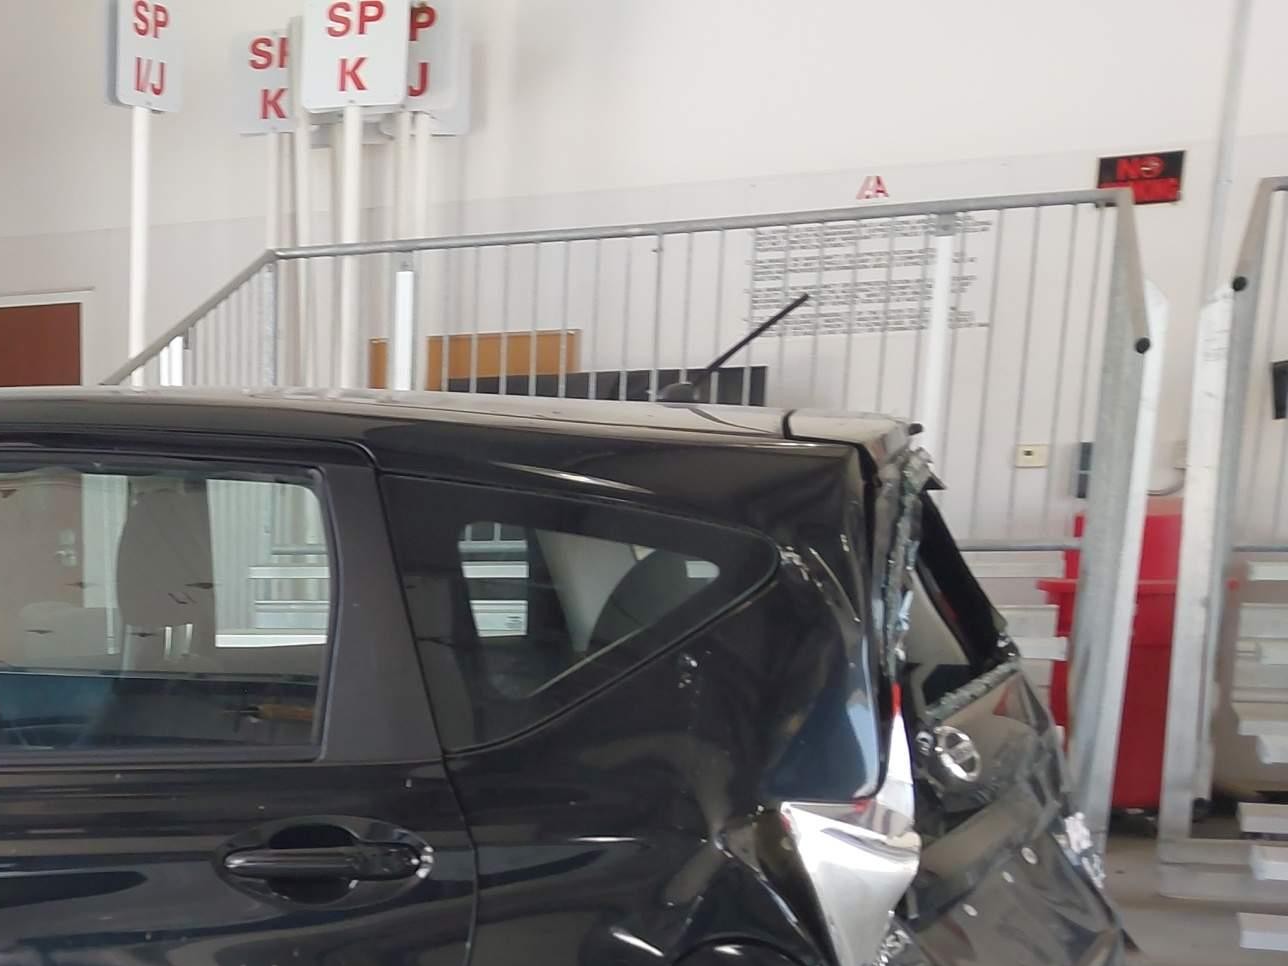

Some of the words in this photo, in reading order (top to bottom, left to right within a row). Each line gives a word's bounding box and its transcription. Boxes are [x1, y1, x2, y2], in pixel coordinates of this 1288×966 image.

[133, 0, 169, 38] SP
[326, 0, 385, 37] SP
[408, 5, 437, 42] P
[338, 57, 368, 92] K
[260, 87, 289, 120] K
